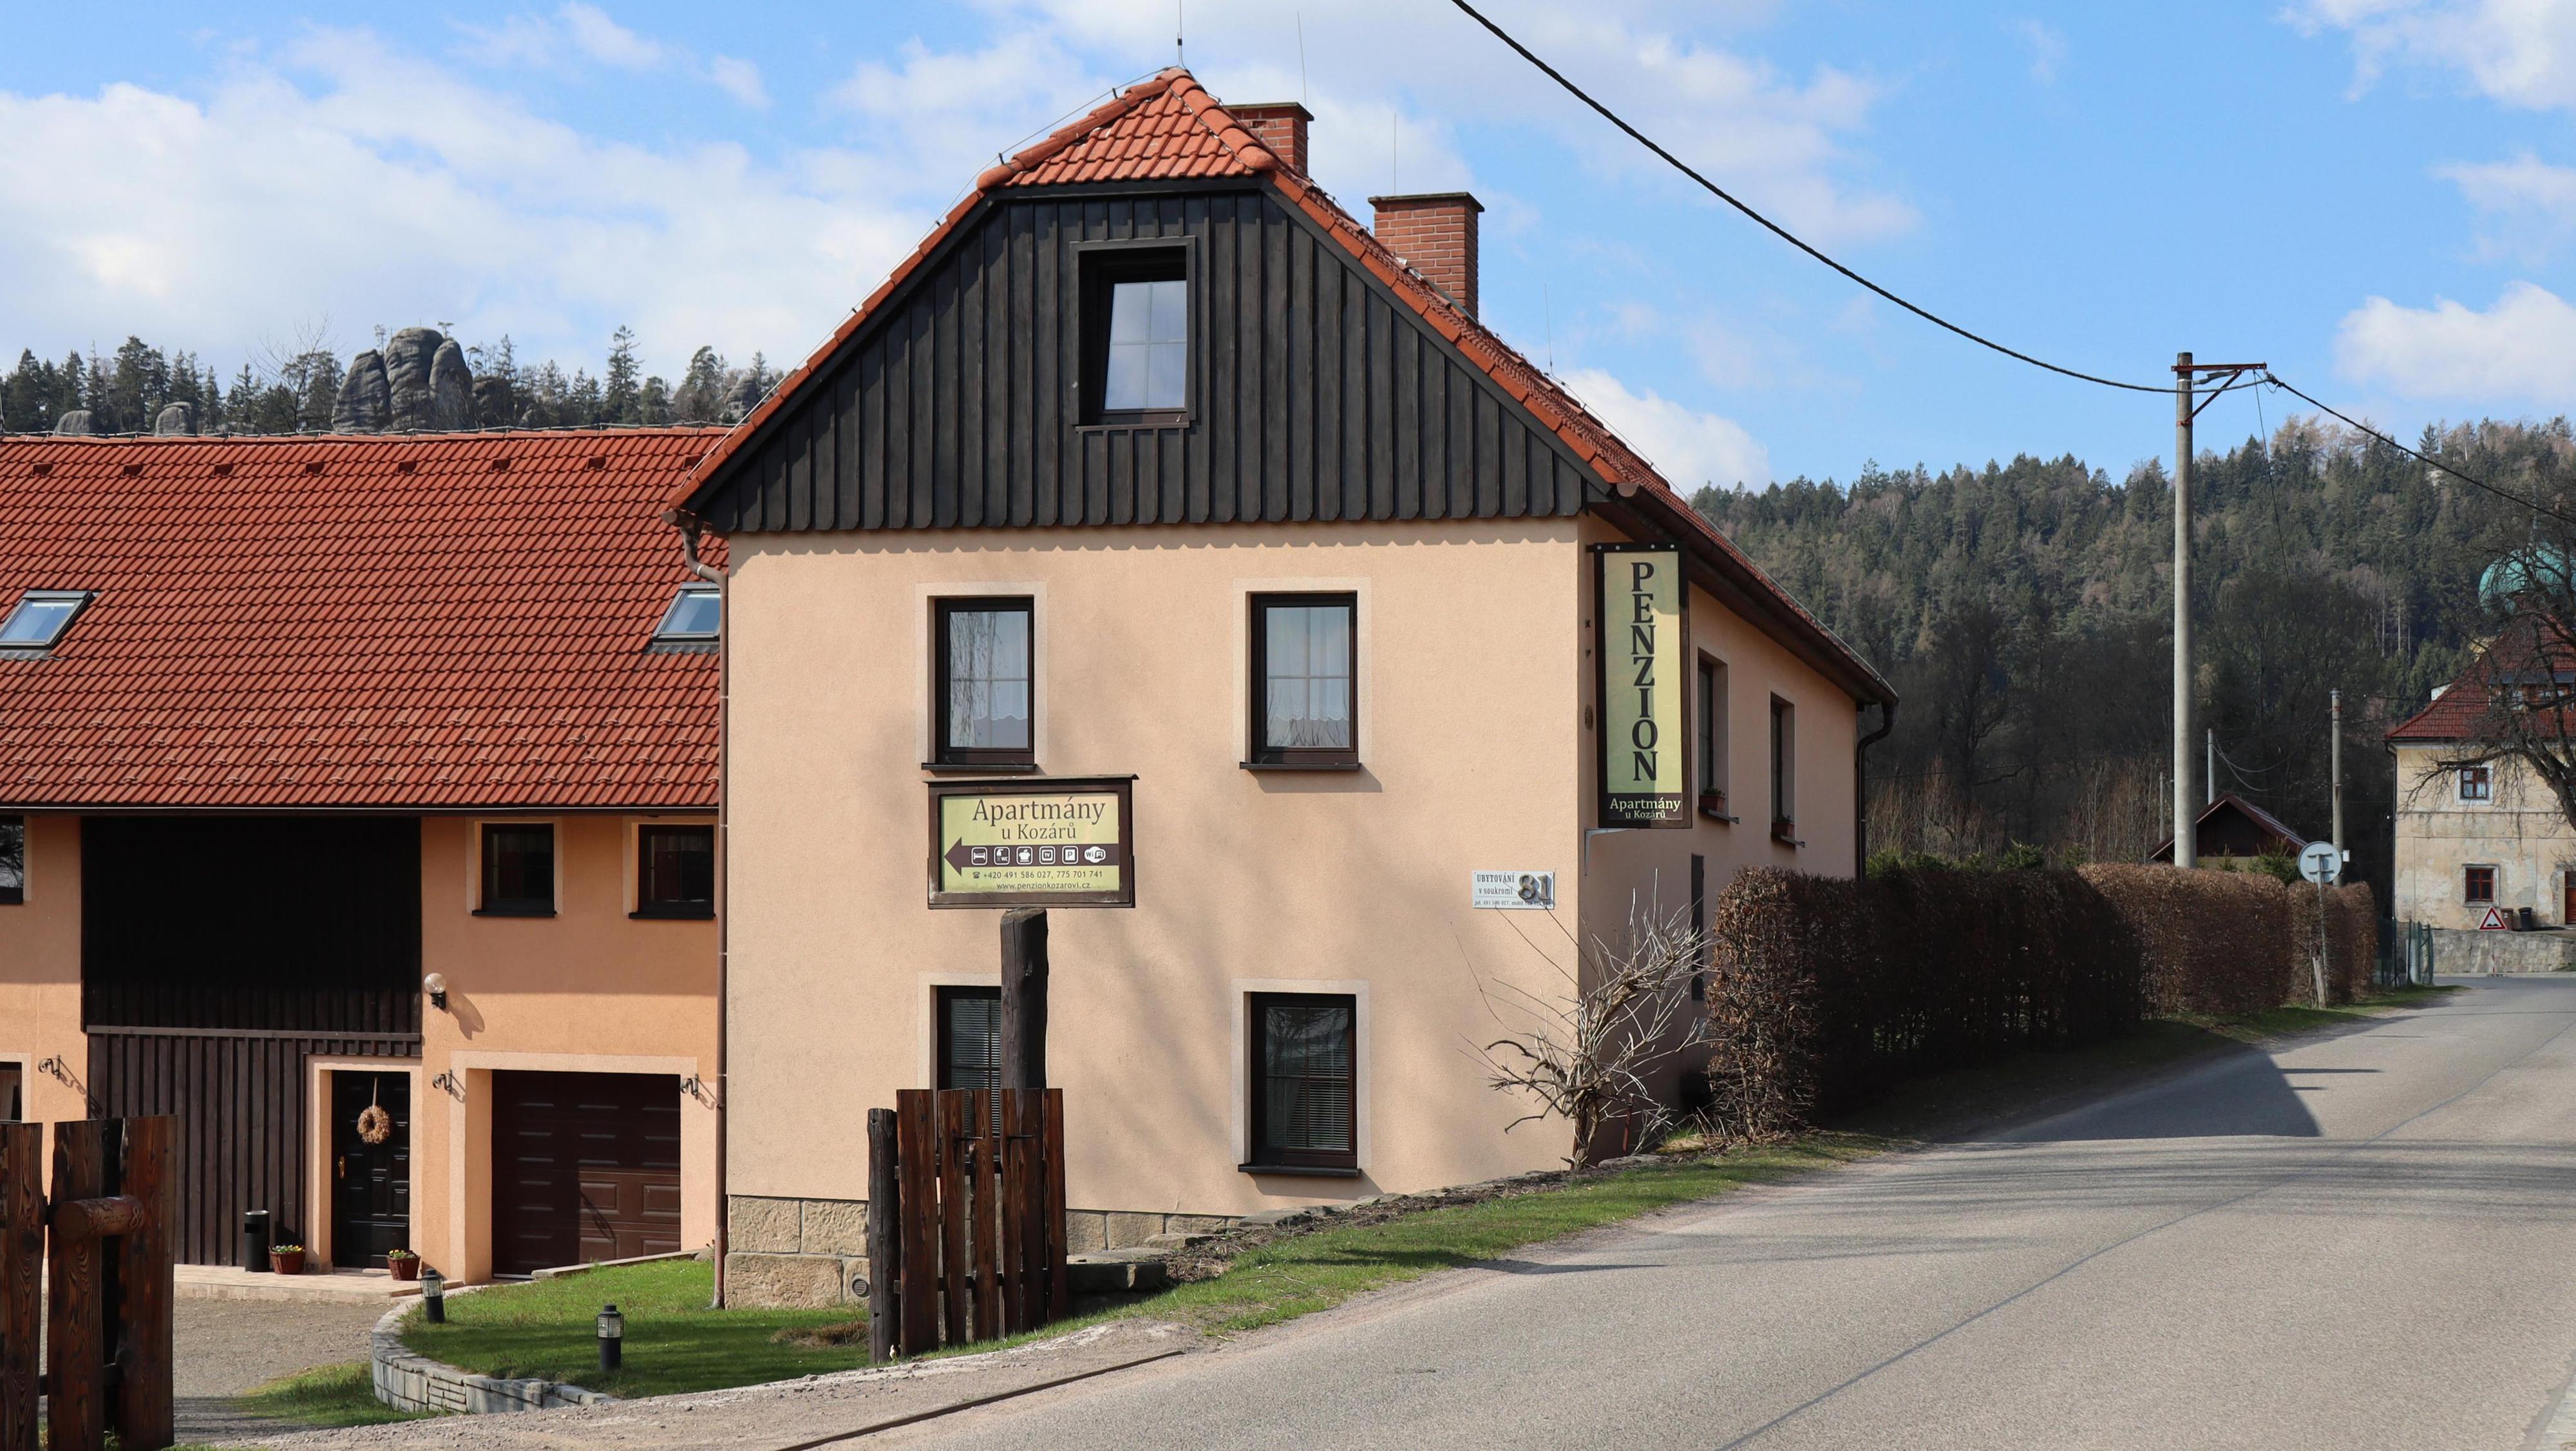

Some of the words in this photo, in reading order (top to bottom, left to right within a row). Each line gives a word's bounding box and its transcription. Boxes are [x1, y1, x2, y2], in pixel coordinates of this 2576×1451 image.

[1631, 562, 1658, 781] PENZION
[972, 796, 1106, 826] Apartmány
[1610, 797, 1681, 812] Apartmány
[1634, 810, 1665, 819] Kozárů
[1001, 828, 1010, 839] u
[1018, 822, 1076, 839] Kozárů
[1477, 872, 1515, 883] UBYTOVÁNÍ
[1484, 886, 1513, 895] soukromí
[1518, 873, 1549, 902] 81
